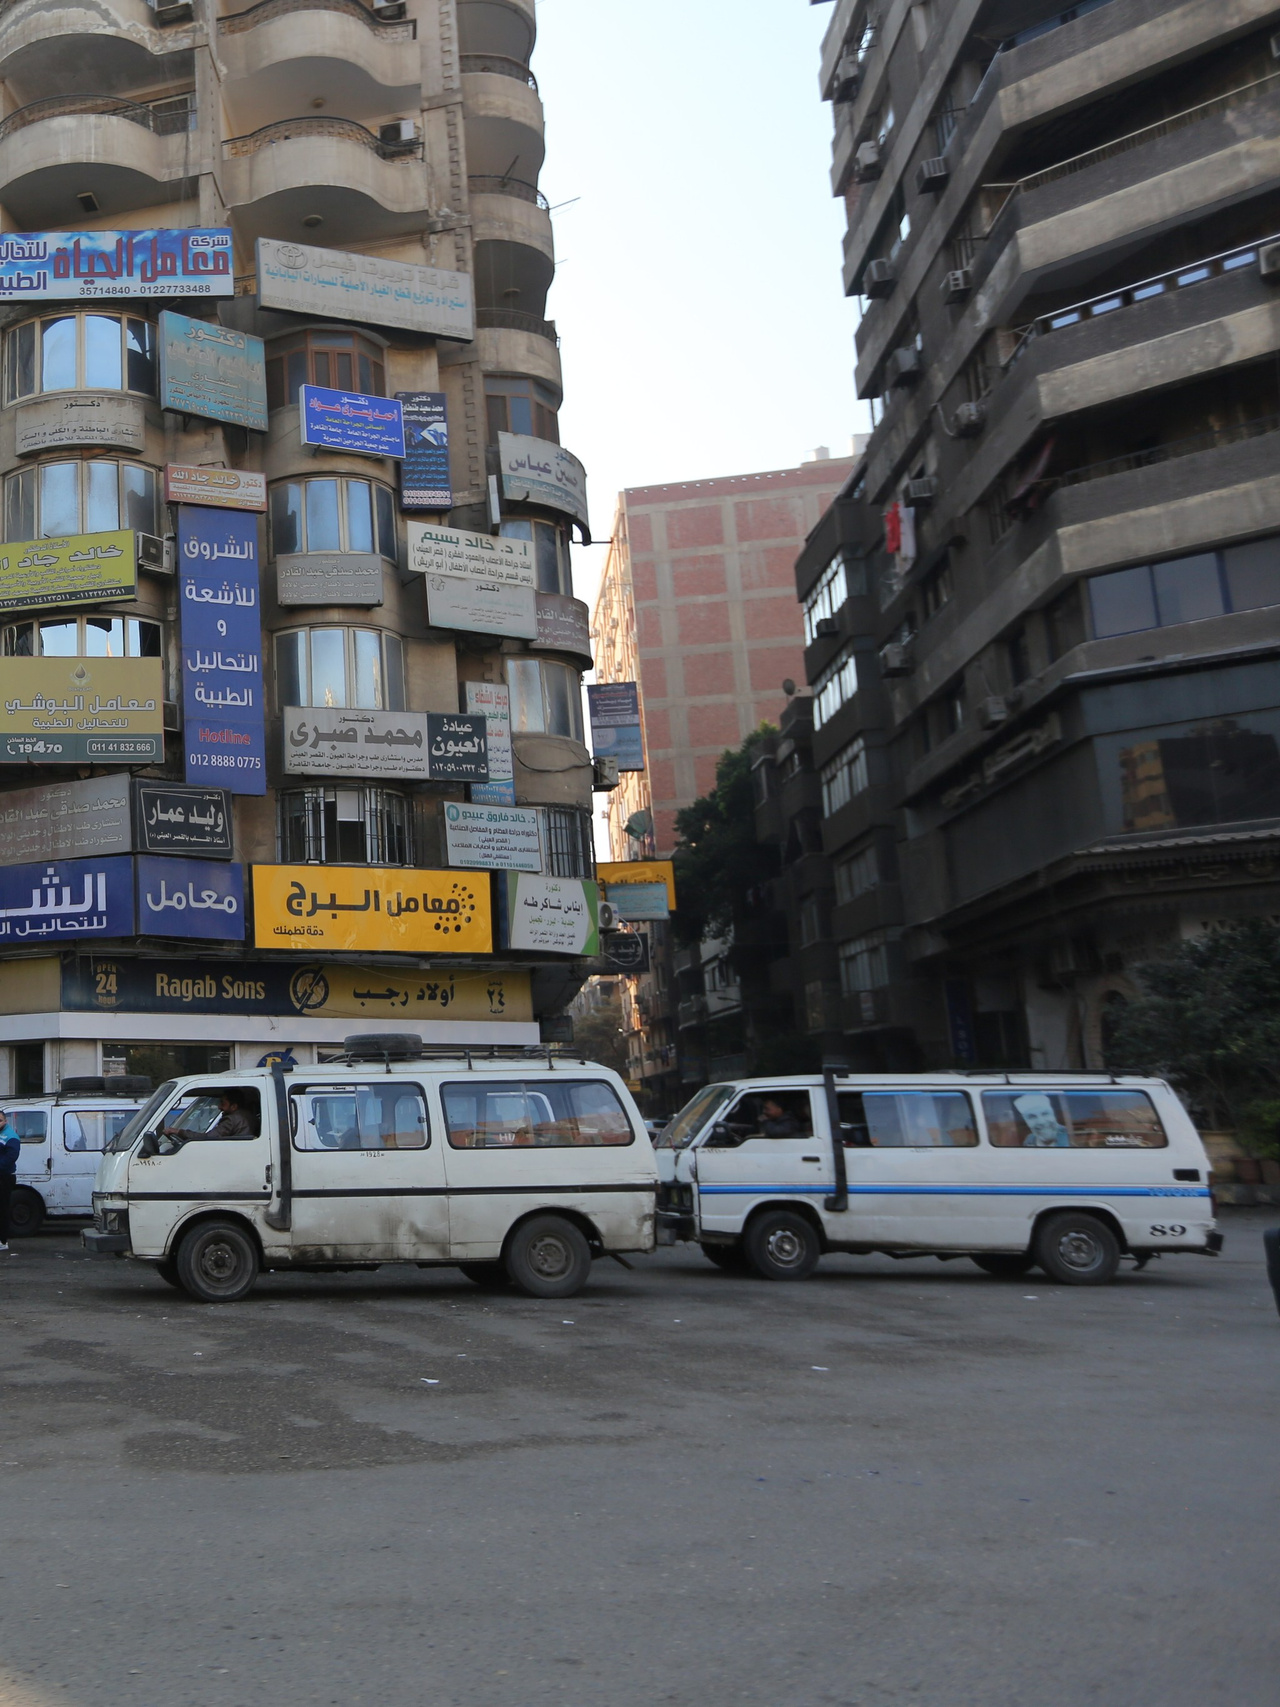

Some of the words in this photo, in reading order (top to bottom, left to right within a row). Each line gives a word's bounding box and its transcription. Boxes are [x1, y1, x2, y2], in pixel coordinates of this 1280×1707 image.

[189, 235, 229, 248] شركة
[54, 236, 134, 285] الحياة
[141, 237, 230, 283] معامل
[303, 272, 338, 287] للسيارات
[79, 287, 131, 295] 35714840
[140, 285, 211, 295] 01227733488
[184, 326, 245, 350] دكتور
[64, 400, 100, 410] دكتور
[309, 398, 341, 411] عواد
[341, 396, 368, 405] دكتور
[508, 454, 552, 476] عباس
[191, 472, 209, 484] جاد
[212, 475, 238, 485] خالد
[183, 533, 254, 561] الشروق
[421, 532, 460, 548] بسيم
[465, 536, 495, 551] خالد
[18, 553, 59, 568] جاد
[69, 545, 123, 562] خالد
[280, 566, 305, 578] القادر
[355, 567, 378, 575] محمد
[185, 579, 256, 608] للأشعة
[475, 584, 500, 592] دكتور
[216, 618, 228, 637] و
[186, 650, 258, 675] التحاليل
[5, 693, 84, 716] البوشي
[89, 695, 156, 714] معامل
[194, 685, 253, 710] الطبية
[32, 718, 73, 730] الطبية
[77, 718, 128, 730] للتحاليل
[338, 714, 374, 723] دكتور
[443, 718, 473, 733] عيادة
[198, 728, 251, 746] Hotline
[289, 721, 358, 751] صبرى
[364, 727, 423, 749] محمد
[19, 740, 63, 754] 19470
[91, 743, 106, 751] 011
[108, 743, 117, 751] 41
[119, 743, 134, 751] 832
[136, 743, 151, 751] 666
[431, 736, 485, 756] العيون
[189, 753, 209, 767] 012
[210, 753, 236, 768] 8888
[238, 755, 261, 770] 0775
[289, 760, 311, 768] القاهرة
[50, 801, 90, 820] صدقى
[92, 797, 127, 812] محمد
[147, 799, 185, 826] عمار
[25, 807, 48, 822] عبد
[188, 803, 224, 832] وليد
[486, 811, 508, 822] فاروق
[510, 815, 526, 823] خالد
[145, 879, 239, 915] معامل
[285, 880, 380, 919] البرج
[386, 892, 461, 916] معامل
[540, 898, 562, 911] شاكر
[14, 915, 108, 937] للتحاليل
[272, 925, 305, 936] تطمنك
[305, 925, 324, 938] دقة
[95, 973, 118, 994] 24
[156, 973, 217, 1002] Ragab
[222, 975, 265, 999] Sons
[417, 974, 455, 1007] أولاد
[352, 986, 409, 1007] رجب
[486, 987, 505, 1007] ٢٤
[365, 1151, 381, 1159] 1928
[1149, 1224, 1187, 1237] 89
